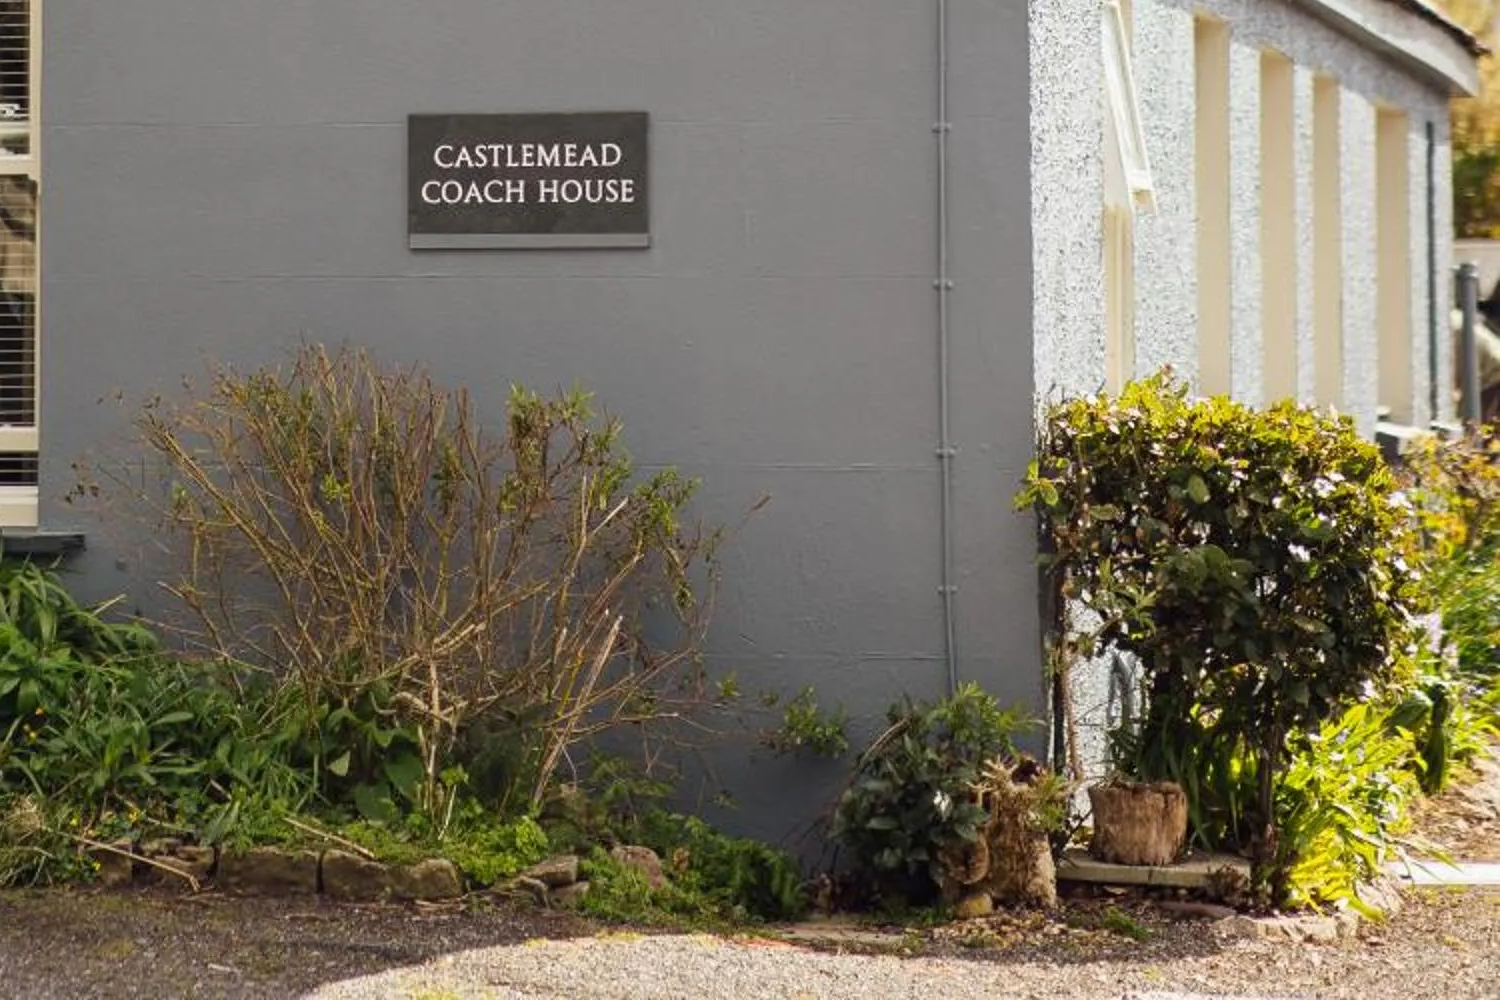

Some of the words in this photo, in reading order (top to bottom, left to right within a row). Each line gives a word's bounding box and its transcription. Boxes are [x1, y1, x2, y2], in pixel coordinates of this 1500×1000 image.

[433, 142, 623, 169] CASTLEMEAD
[420, 178, 526, 205] COACH
[538, 177, 636, 204] HOUSE
